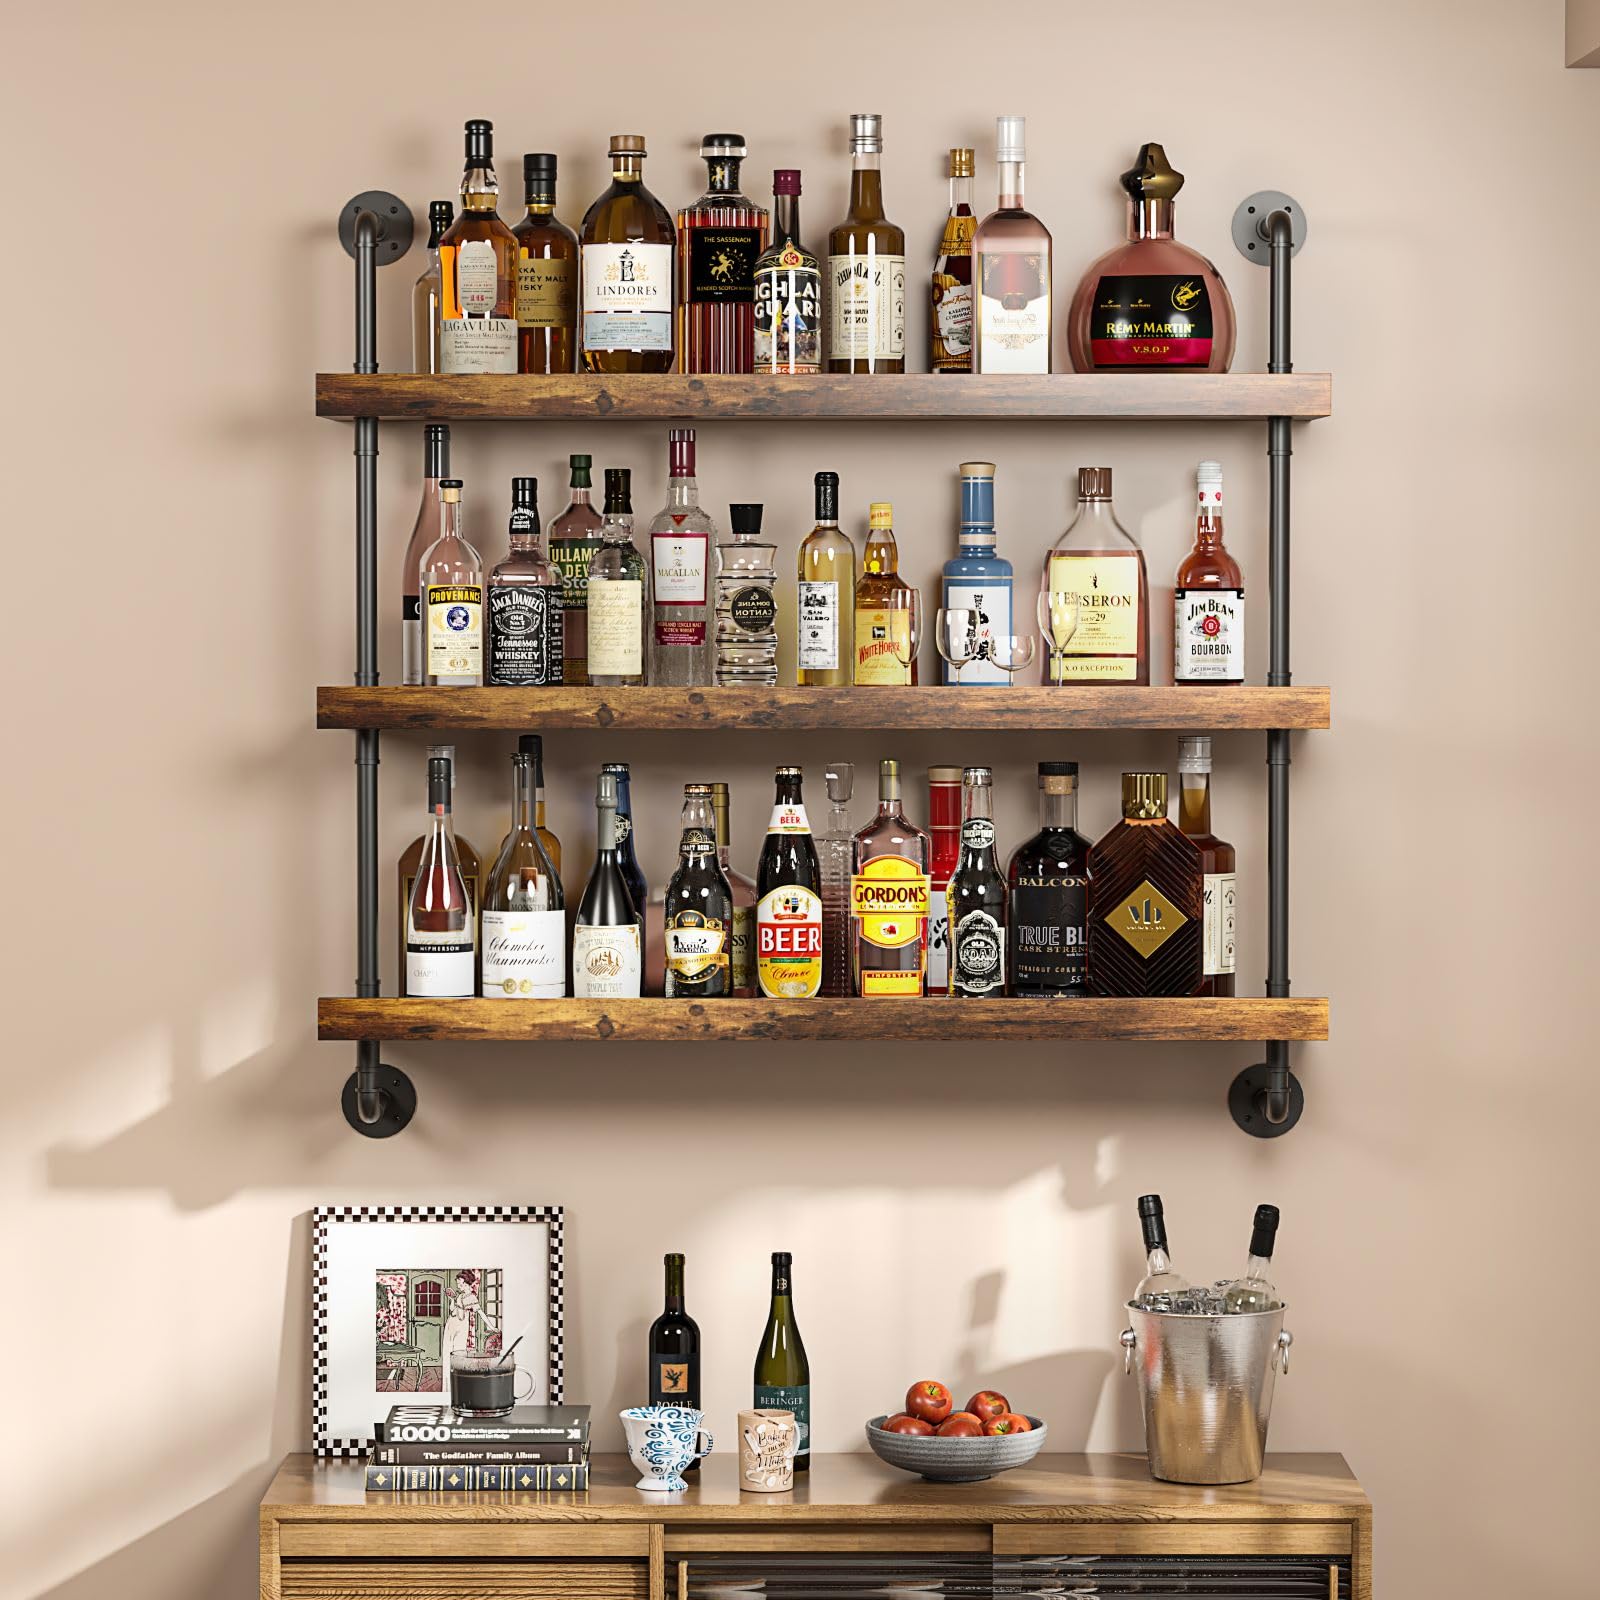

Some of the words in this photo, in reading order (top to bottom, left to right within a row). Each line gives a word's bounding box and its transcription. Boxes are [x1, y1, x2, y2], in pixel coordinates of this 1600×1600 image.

[596, 285, 657, 296] LINDORES
[443, 321, 507, 332] LAGAVULIN
[657, 568, 700, 577] MACALLAN
[430, 590, 481, 603] PROVENANCE
[491, 593, 510, 612] JACK
[511, 590, 544, 613] DANIEL'S
[1187, 603, 1206, 621] JIM
[1208, 599, 1234, 619] BEAM
[1095, 613, 1106, 622] 29
[497, 636, 538, 648] Tennessee
[858, 643, 878, 665] WHITE
[1191, 644, 1232, 655] BOURBON
[494, 651, 540, 660] WHISKEY
[780, 816, 801, 825] BEER
[855, 885, 927, 903] GORDON'S
[761, 927, 822, 952] BEER
[1018, 925, 1060, 945] TRUE
[1018, 945, 1043, 953] CASK
[760, 1396, 804, 1405] BERINGER
[389, 1426, 451, 1442] 1000
[486, 1452, 513, 1460] Family
